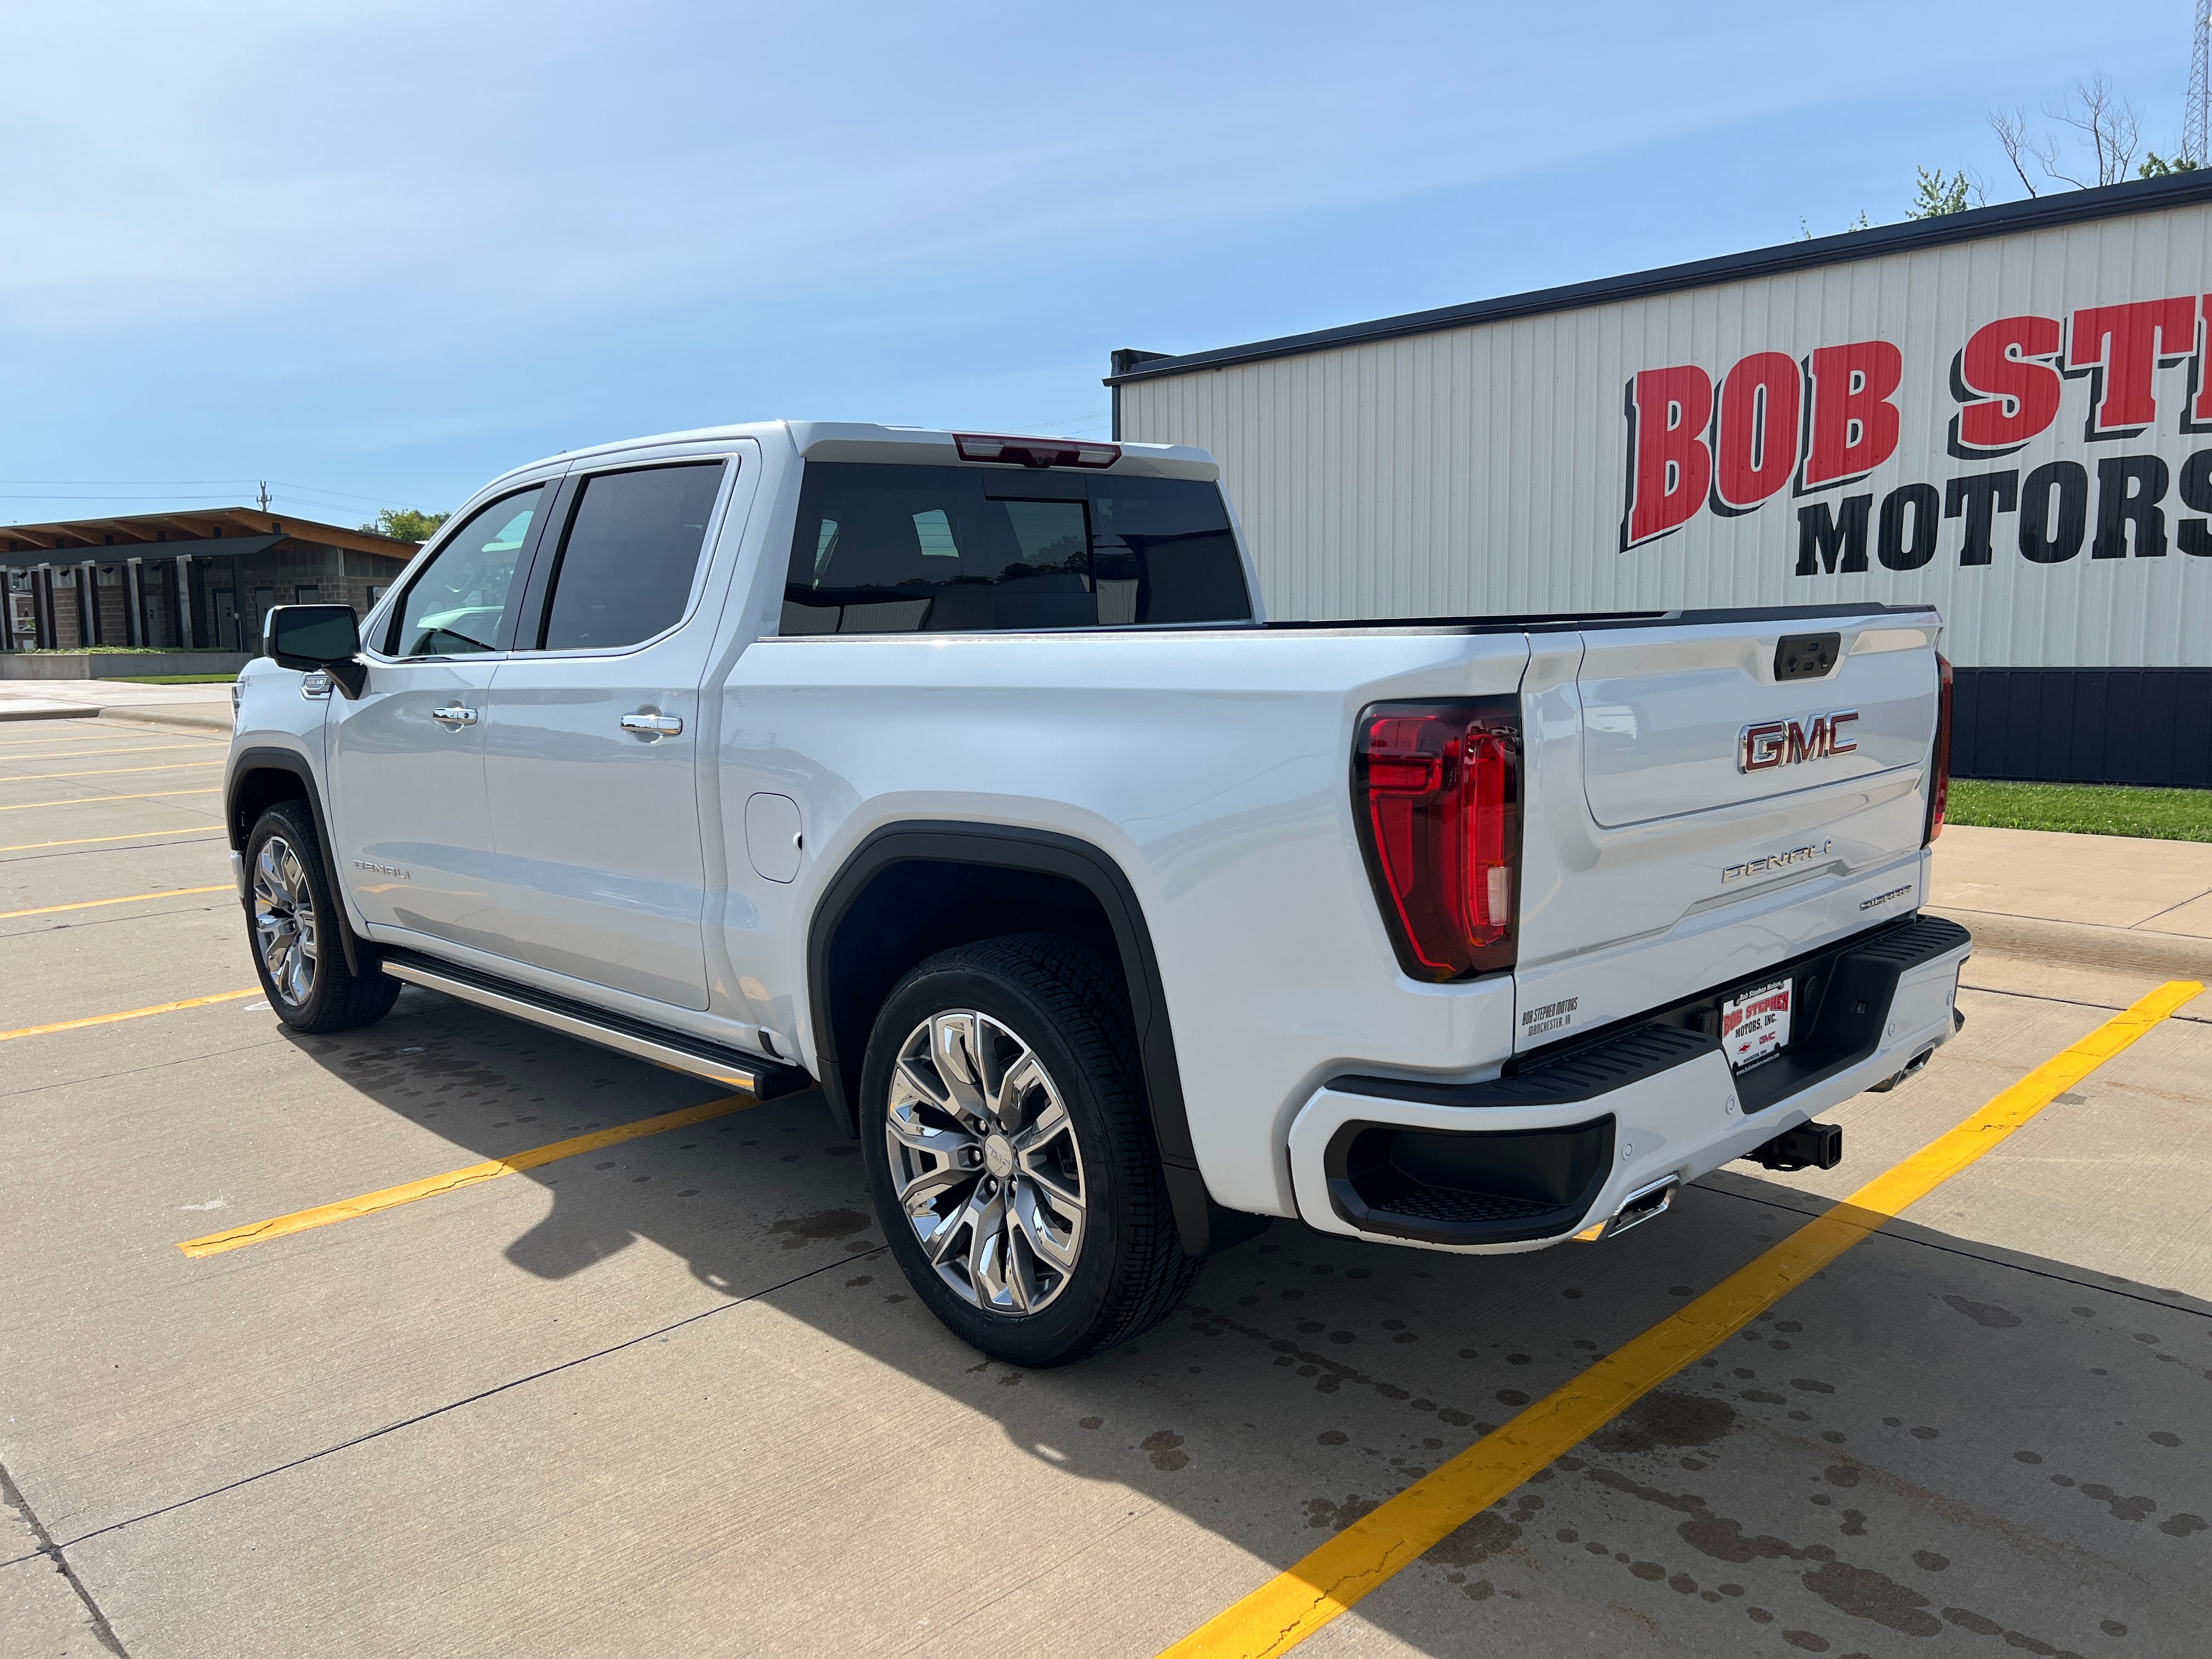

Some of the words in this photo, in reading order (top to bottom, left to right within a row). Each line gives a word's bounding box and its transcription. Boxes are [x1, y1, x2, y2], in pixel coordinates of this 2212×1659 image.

[1620, 340, 1902, 553] BOB
[1948, 293, 2212, 460] ST
[1737, 708, 1859, 775] GMC
[353, 859, 410, 879] DENALI
[1722, 839, 1831, 883] DENALI
[1860, 884, 1912, 911] SIERRA
[1740, 992, 1748, 1001] Bob
[1522, 1010, 1533, 1026] BOB
[1533, 1003, 1556, 1022] STEPHEN
[1556, 997, 1578, 1015] MOTORS
[1565, 1014, 1571, 1025] IA
[1723, 1008, 1743, 1039] BOB
[1746, 990, 1790, 1020] STEPHEN
[1735, 1018, 1762, 1038] MOTORS,
[1764, 1013, 1777, 1026] INC.
[1759, 1031, 1776, 1045] GMC
[985, 1143, 1011, 1170] GMC
